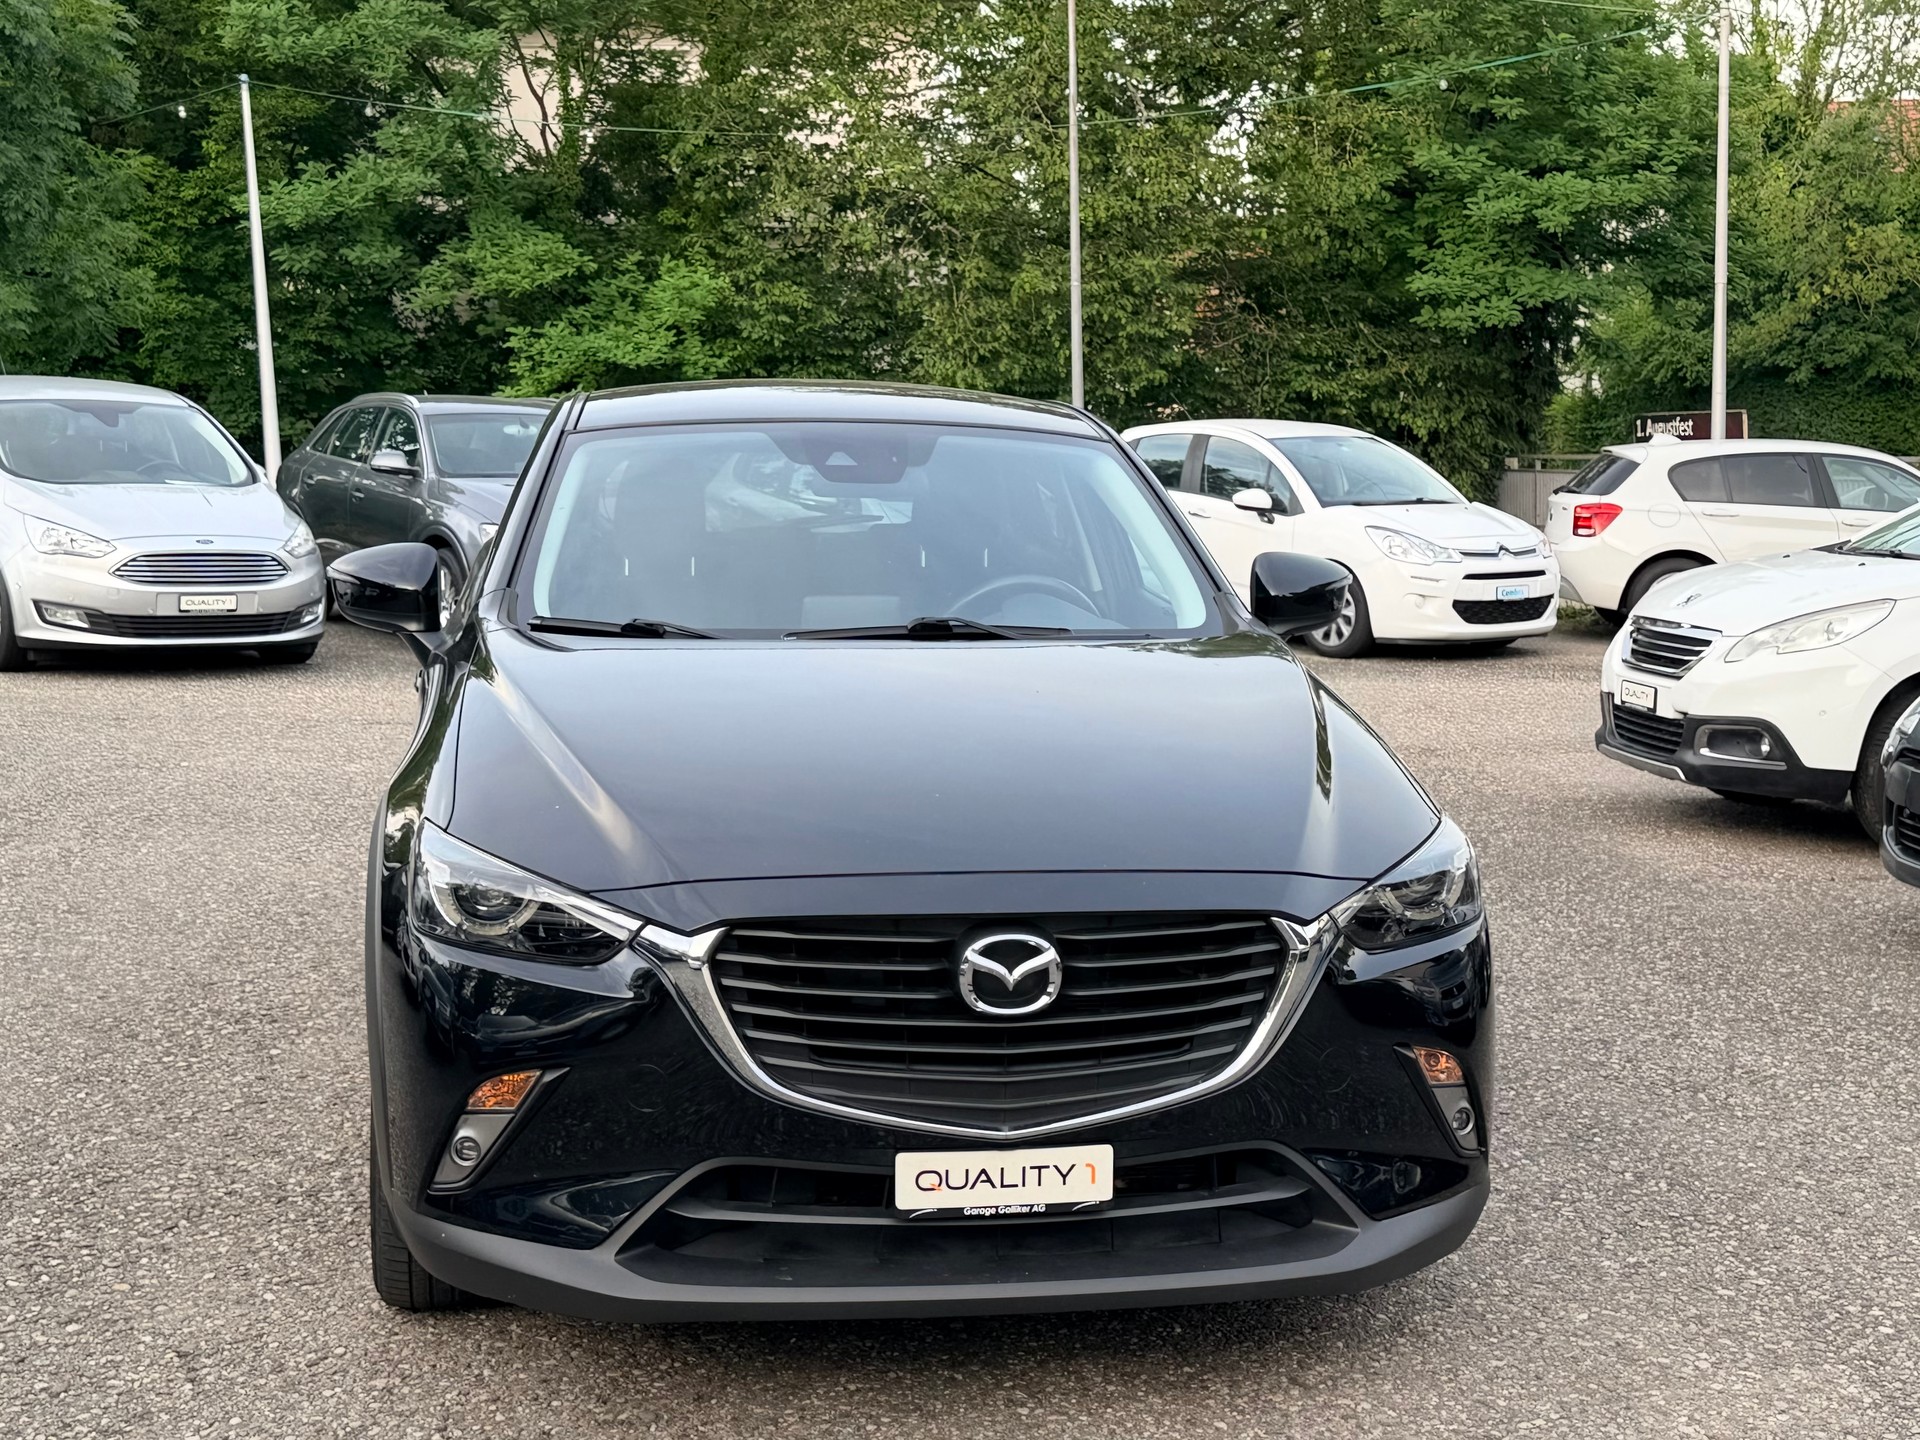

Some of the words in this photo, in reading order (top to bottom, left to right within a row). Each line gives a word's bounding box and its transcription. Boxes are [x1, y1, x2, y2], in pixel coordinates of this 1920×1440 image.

[1636, 419, 1645, 437] 1.
[915, 1163, 1076, 1192] QUALITY
[1085, 1162, 1096, 1185] 1
[963, 1206, 996, 1217] Garage
[1031, 1203, 1046, 1214] AG
